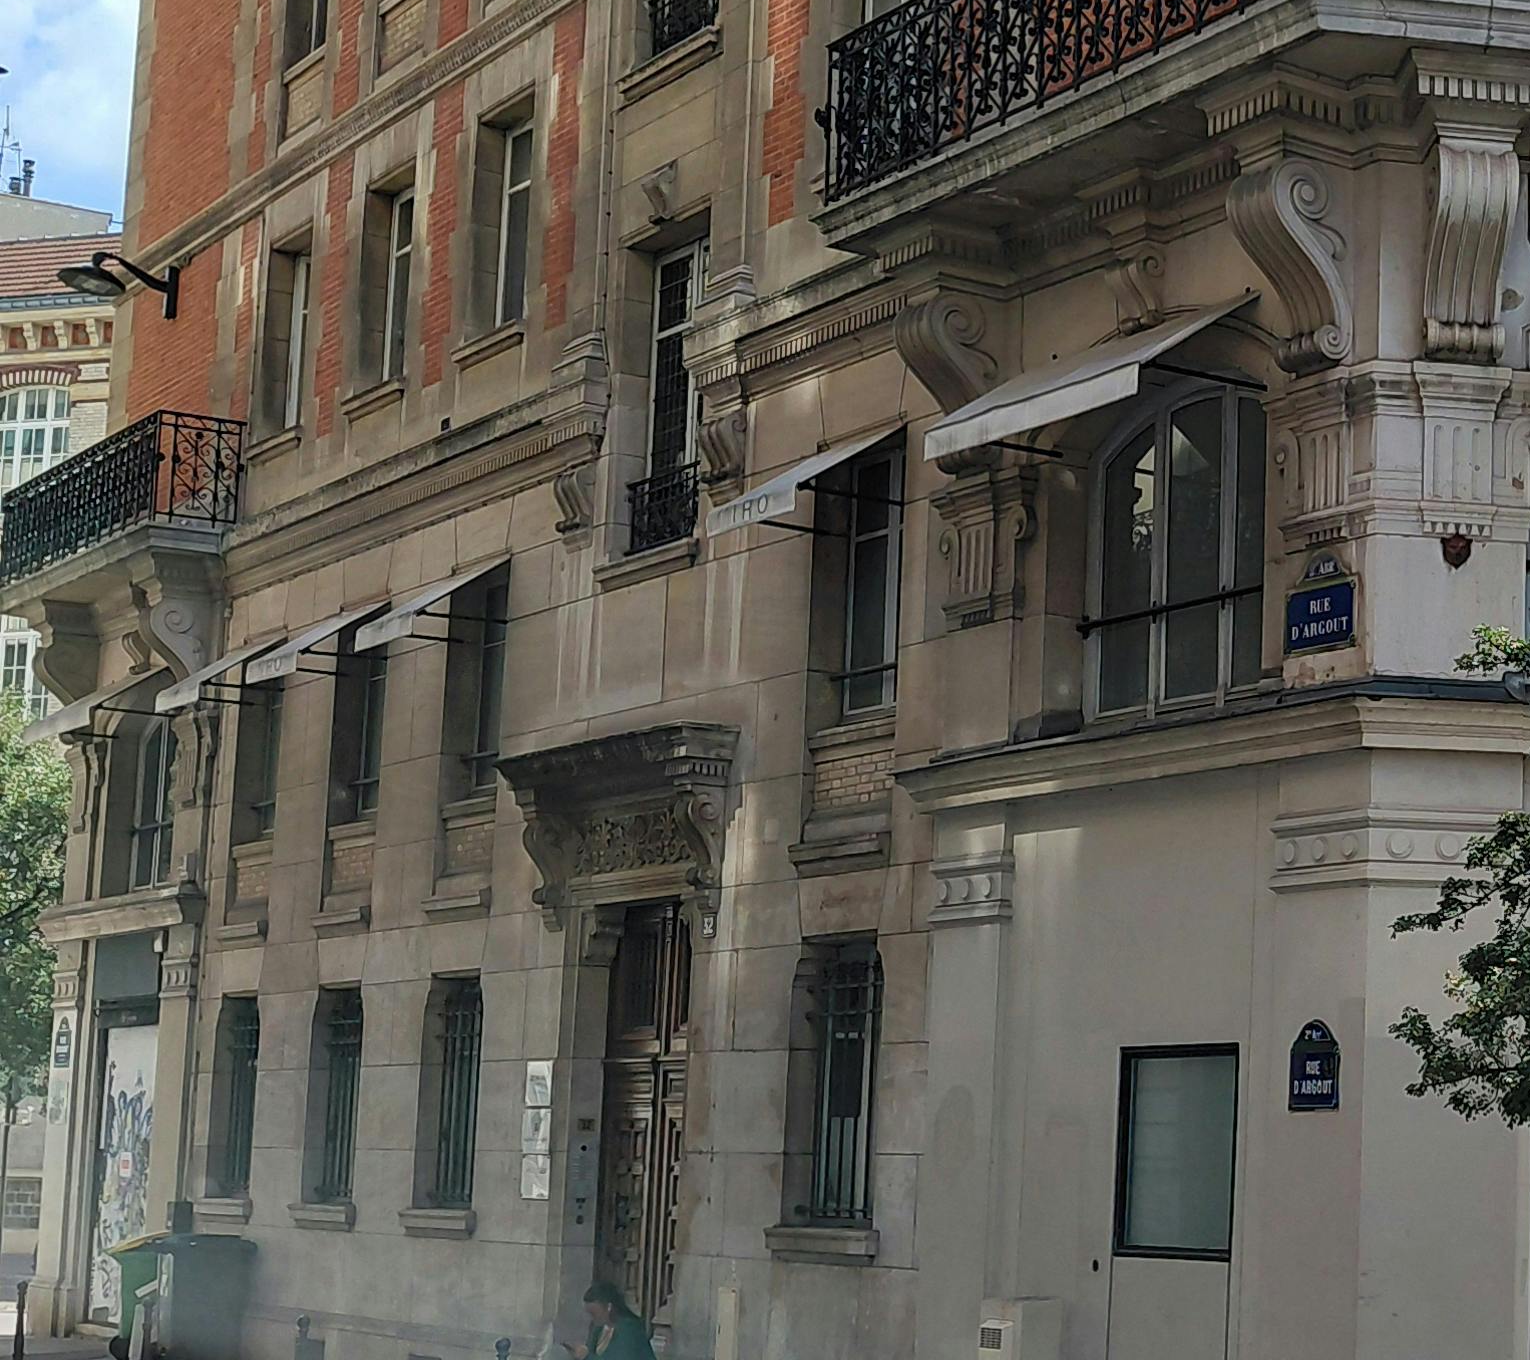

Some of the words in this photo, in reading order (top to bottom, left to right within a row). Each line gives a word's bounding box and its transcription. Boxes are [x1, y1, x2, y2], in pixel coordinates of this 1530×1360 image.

[732, 493, 769, 523] IRO
[1309, 597, 1331, 615] RUE
[1291, 616, 1349, 641] D'ARGOUT
[1305, 1060, 1321, 1075] RUE
[1293, 1079, 1333, 1095] D'ARGOUT
